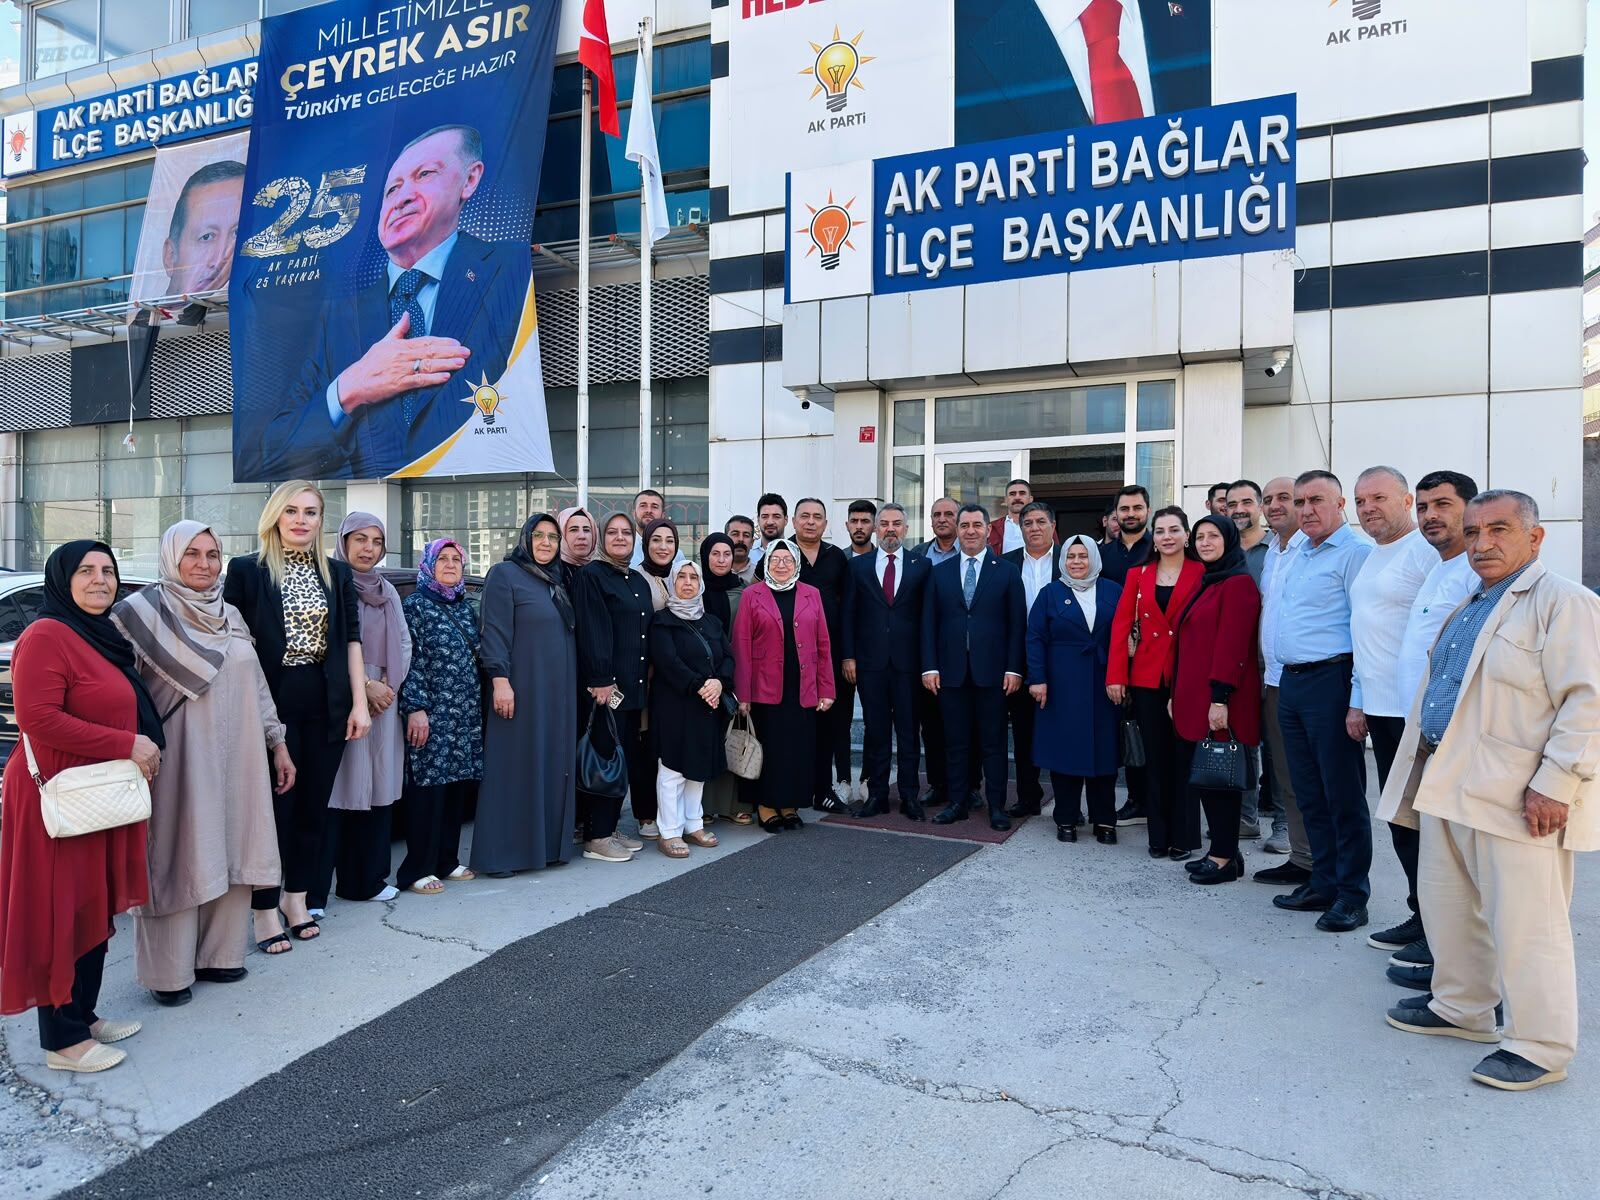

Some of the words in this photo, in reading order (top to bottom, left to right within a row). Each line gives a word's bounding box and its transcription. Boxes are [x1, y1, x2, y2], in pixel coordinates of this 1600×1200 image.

[280, 31, 425, 101] ÇEYREK
[434, 4, 531, 59] ASIR
[1326, 28, 1351, 46] AK
[53, 105, 86, 133] AK
[89, 84, 155, 124] PARTİ
[160, 62, 259, 107] BAĞLAR
[285, 93, 362, 120] TÜRKİYE
[367, 69, 456, 105] GELECEĞE
[462, 50, 517, 81] HAZIR
[53, 130, 102, 160] İLÇE
[115, 88, 255, 146] BAŞKANLIĞ
[807, 119, 826, 133] AK
[885, 165, 942, 217] AK
[954, 134, 1076, 206] PARTİ
[1091, 114, 1291, 188] BAĞLAR
[240, 164, 368, 258] 25
[885, 223, 974, 279] İLÇE
[1002, 171, 1287, 263] BAŞKANLIĞI
[256, 277, 269, 289] 25
[268, 261, 282, 273] AK
[287, 252, 319, 269] PARTİ
[474, 427, 485, 435] AK
